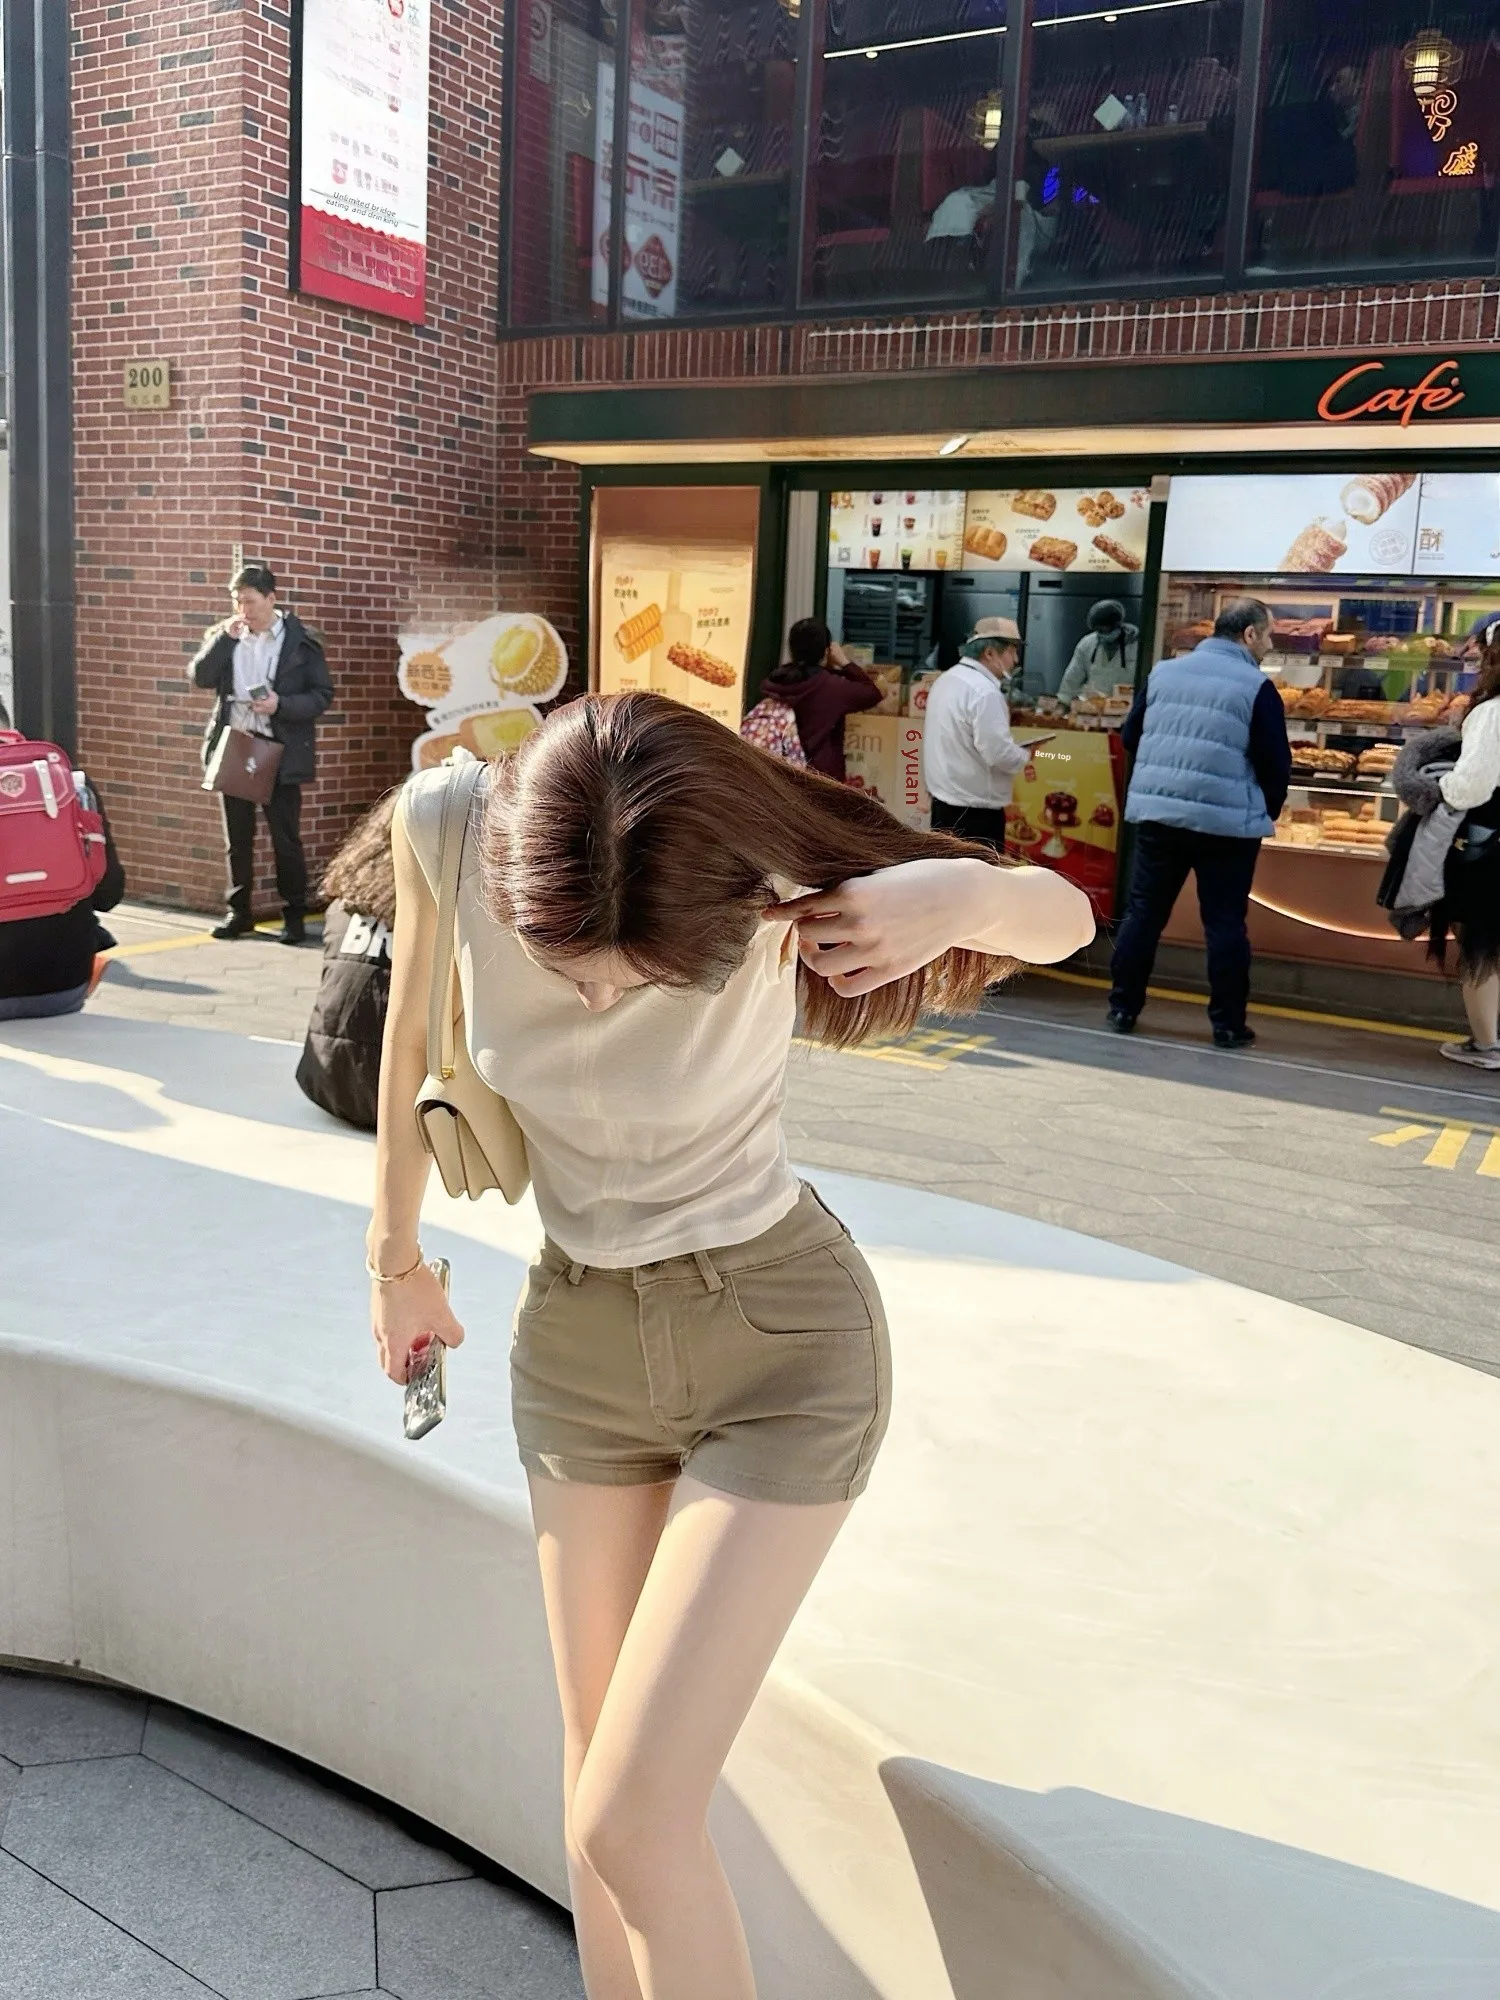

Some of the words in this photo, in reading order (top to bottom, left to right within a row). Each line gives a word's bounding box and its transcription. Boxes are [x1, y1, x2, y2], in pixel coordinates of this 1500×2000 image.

[325, 198, 349, 211] eating
[351, 205, 367, 216] and
[367, 208, 399, 227] drinking
[333, 191, 370, 209] Unlimited
[371, 203, 396, 217] bridge
[128, 367, 162, 388] 200
[1317, 360, 1466, 429] Café
[905, 730, 922, 742] 6
[1035, 750, 1056, 760] Berry
[1057, 753, 1071, 762] top
[901, 749, 919, 805] yuan
